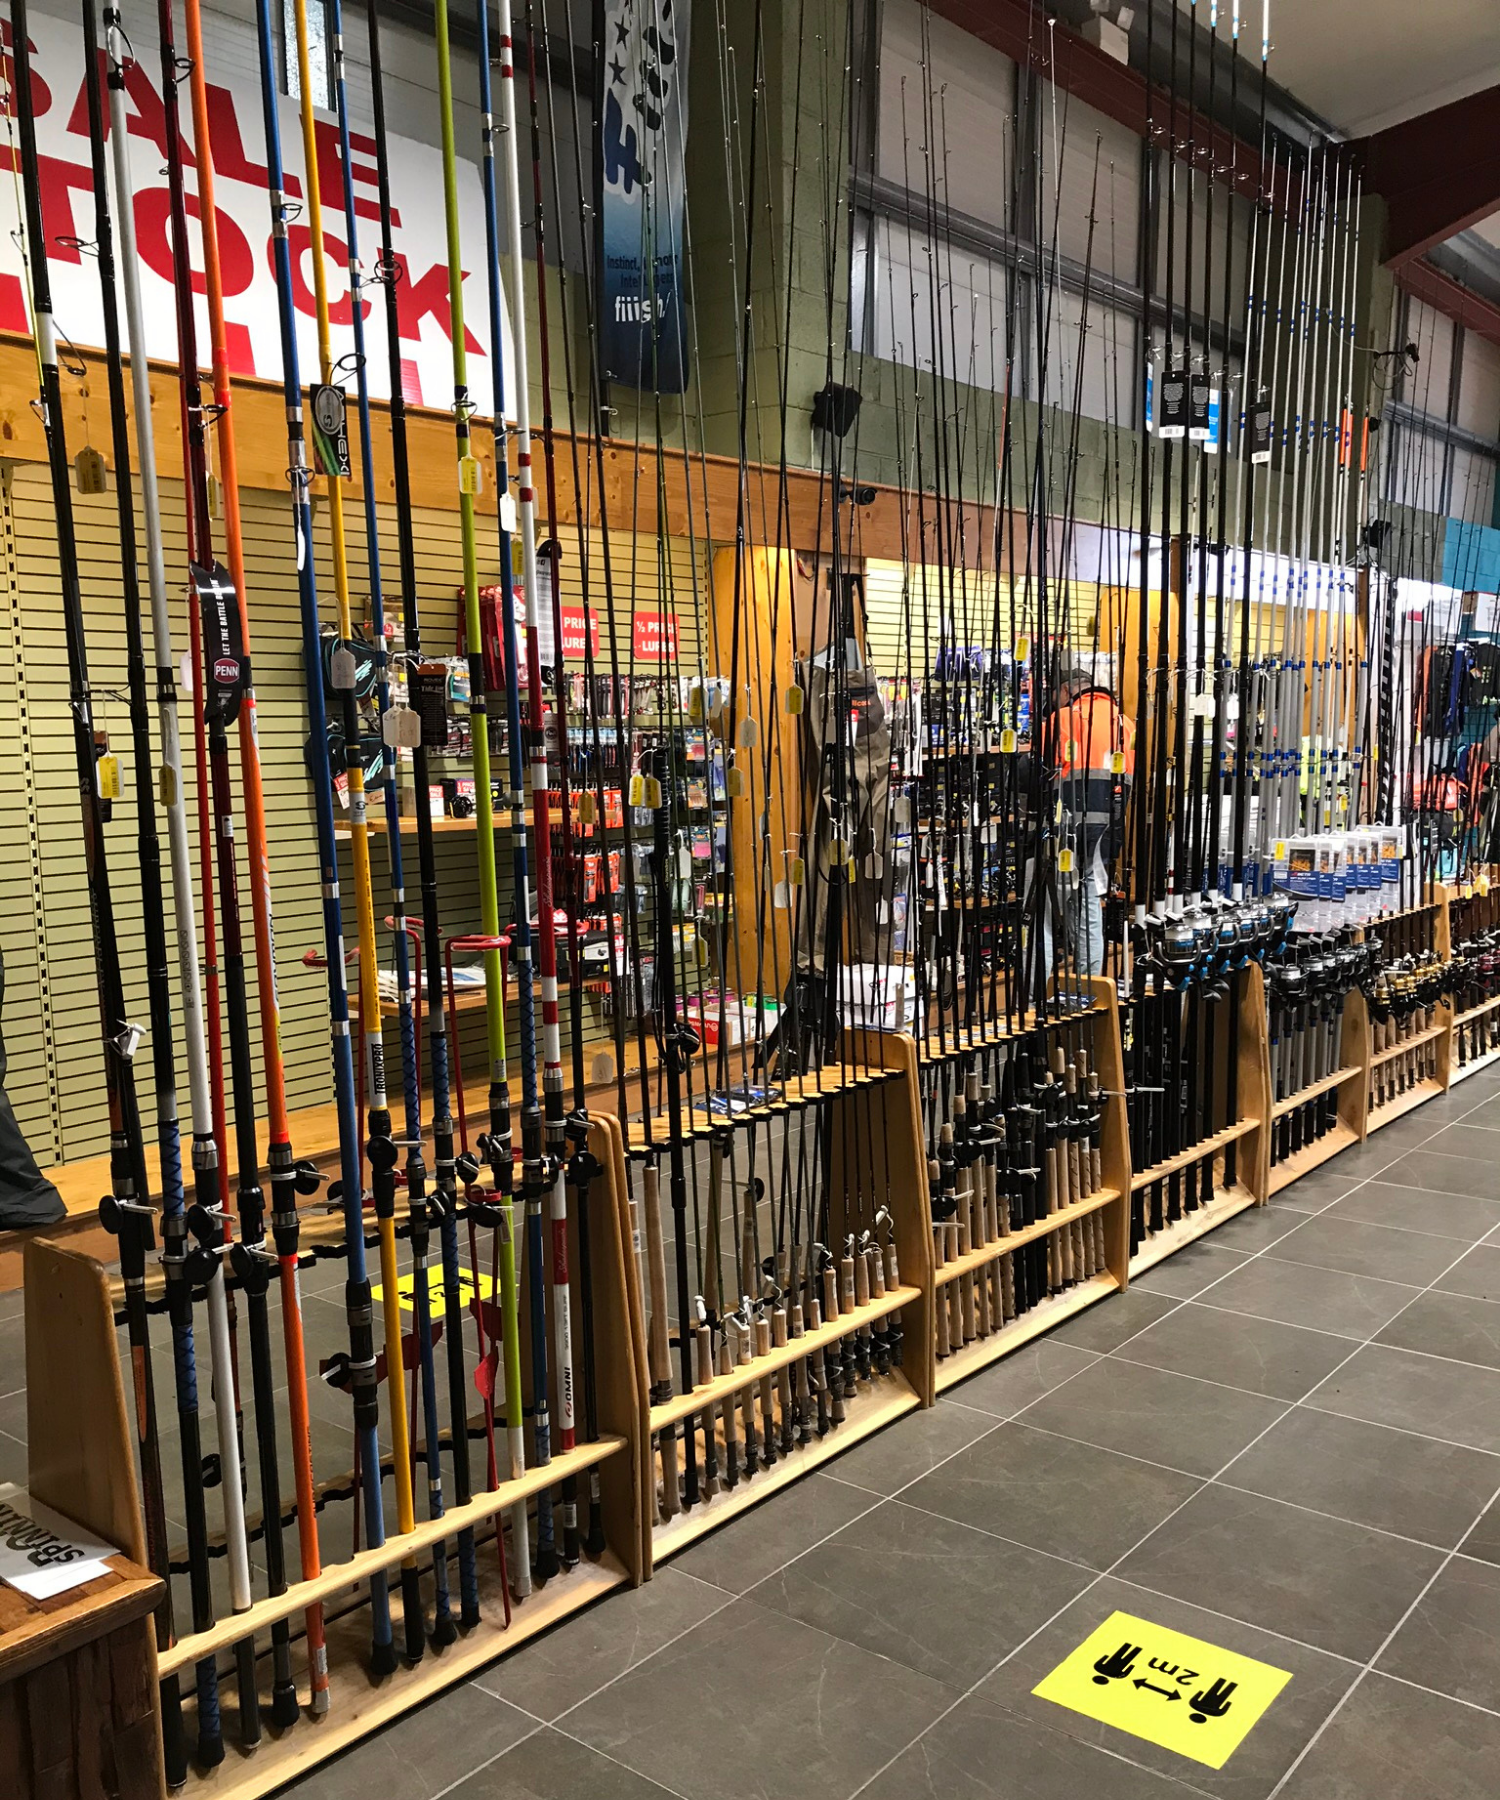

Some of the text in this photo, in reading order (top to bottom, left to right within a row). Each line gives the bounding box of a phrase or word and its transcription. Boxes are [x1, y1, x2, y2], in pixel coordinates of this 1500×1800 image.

[217, 601, 228, 627] BATTLE
[221, 628, 229, 642] THE
[222, 643, 231, 656] LET
[215, 665, 239, 677] PENN
[564, 1366, 572, 1401] OMNI
[1148, 1656, 1200, 1686] 2m
